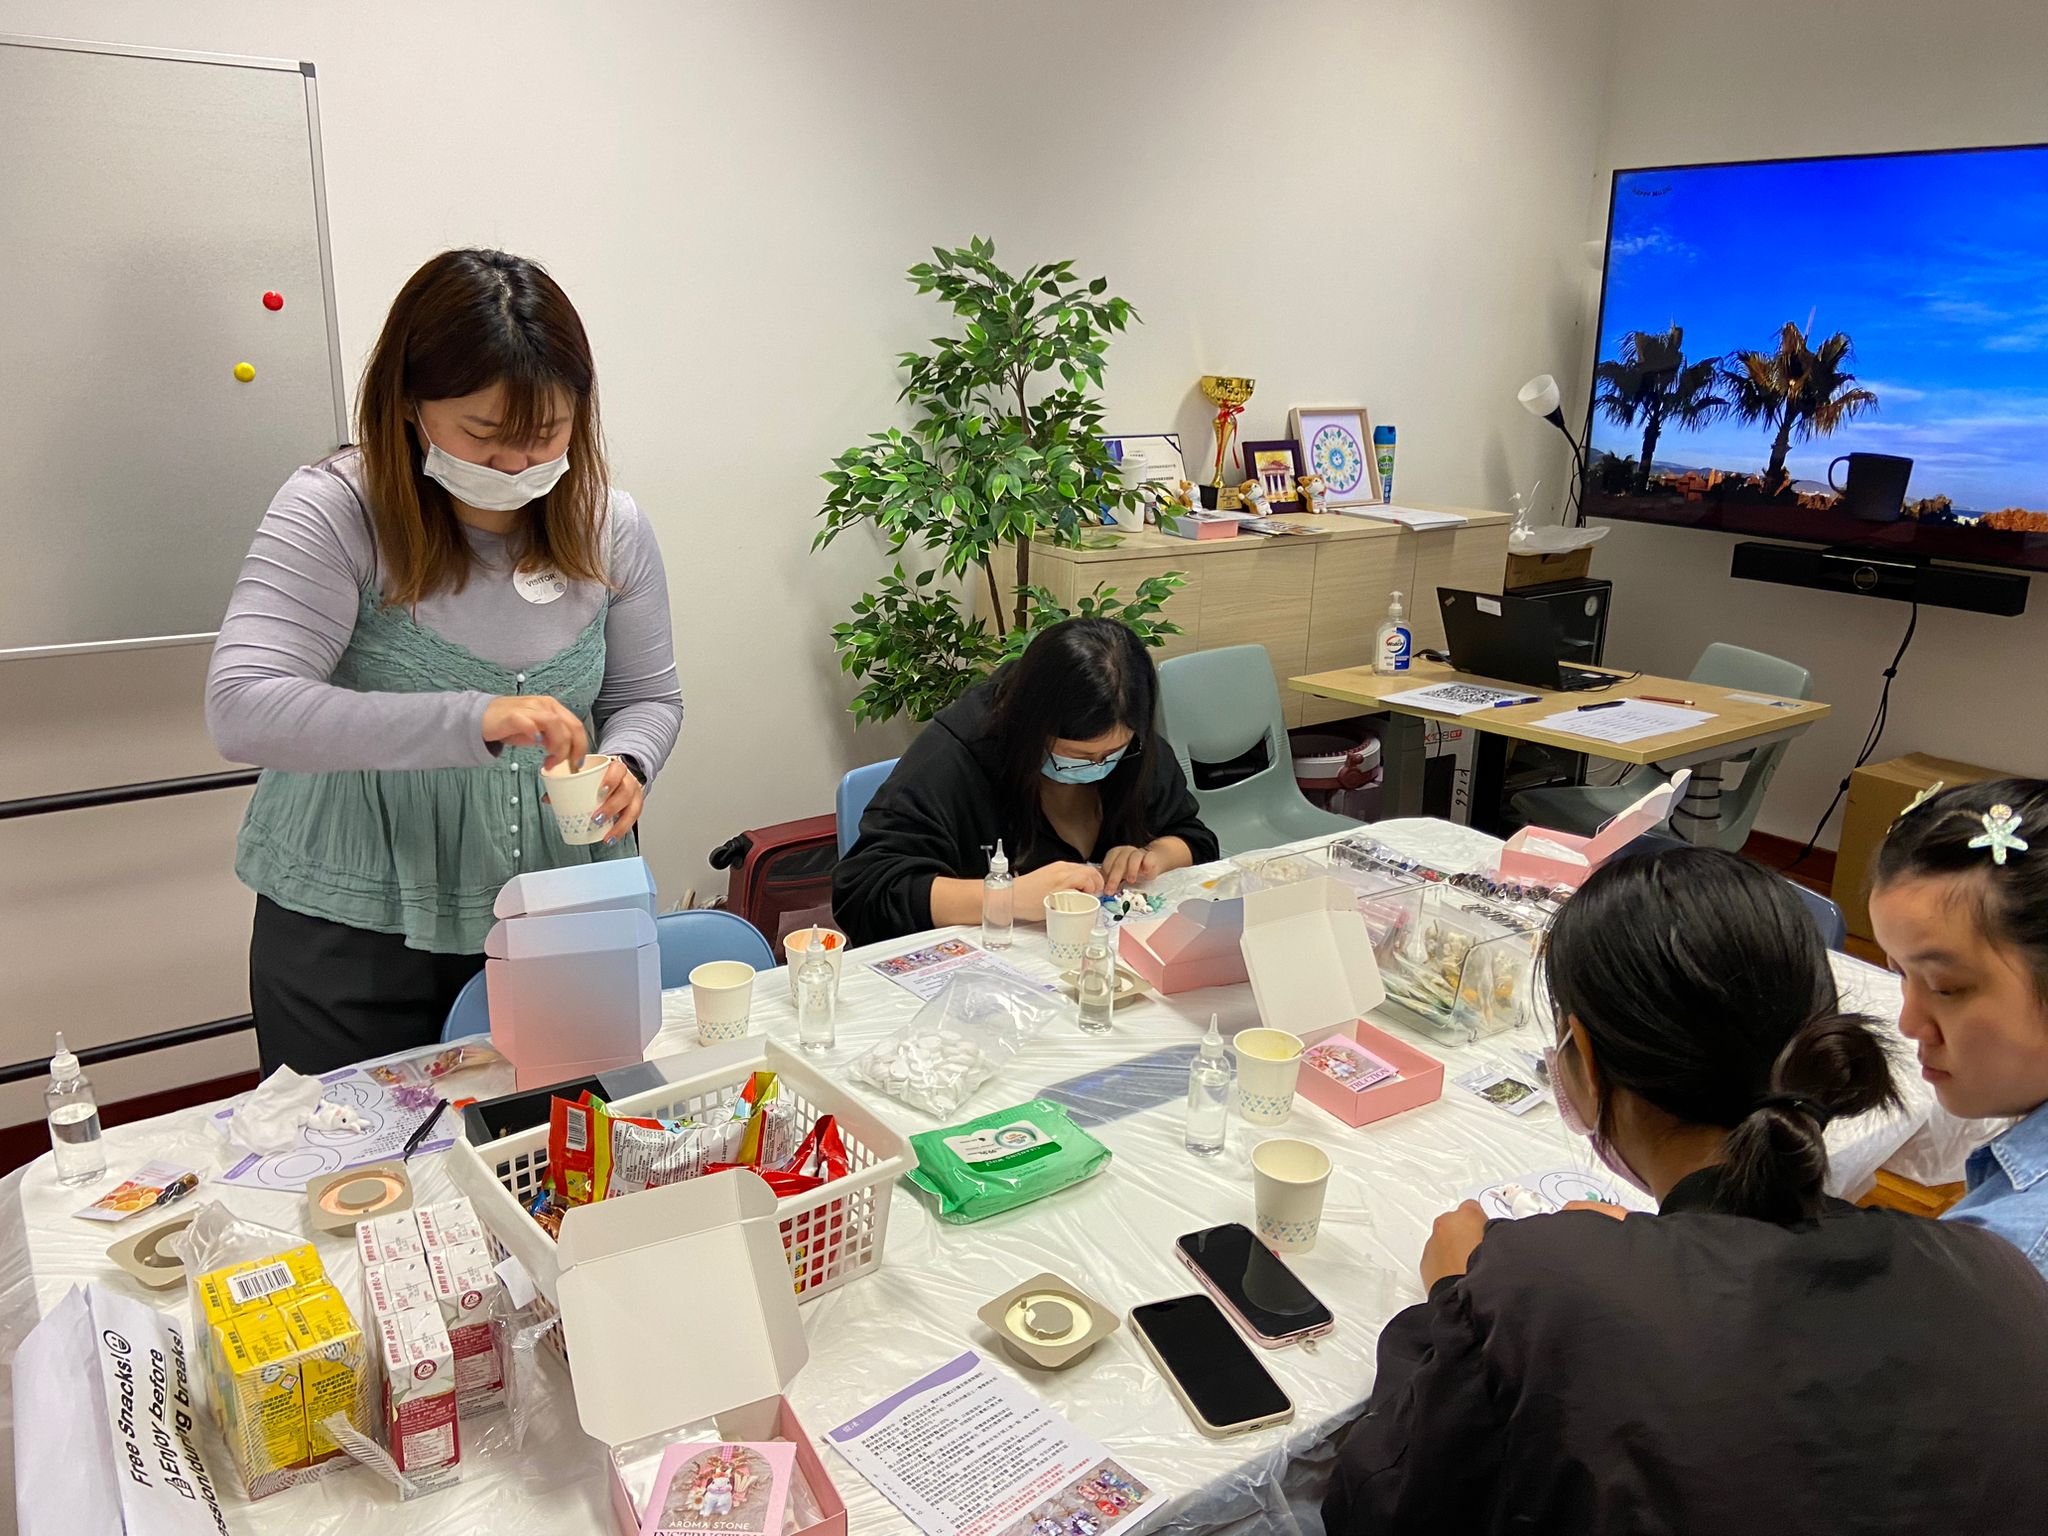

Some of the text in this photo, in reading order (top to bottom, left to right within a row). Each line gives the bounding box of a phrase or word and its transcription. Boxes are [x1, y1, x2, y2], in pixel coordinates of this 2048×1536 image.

[525, 573, 556, 588] VISITOR
[1350, 1069, 1389, 1089] TRUCTION
[168, 1327, 189, 1407] breaks!
[110, 1352, 153, 1488] Free Snacks!
[148, 1348, 181, 1476] Enjoy before
[669, 1520, 750, 1531] AROMA STONE
